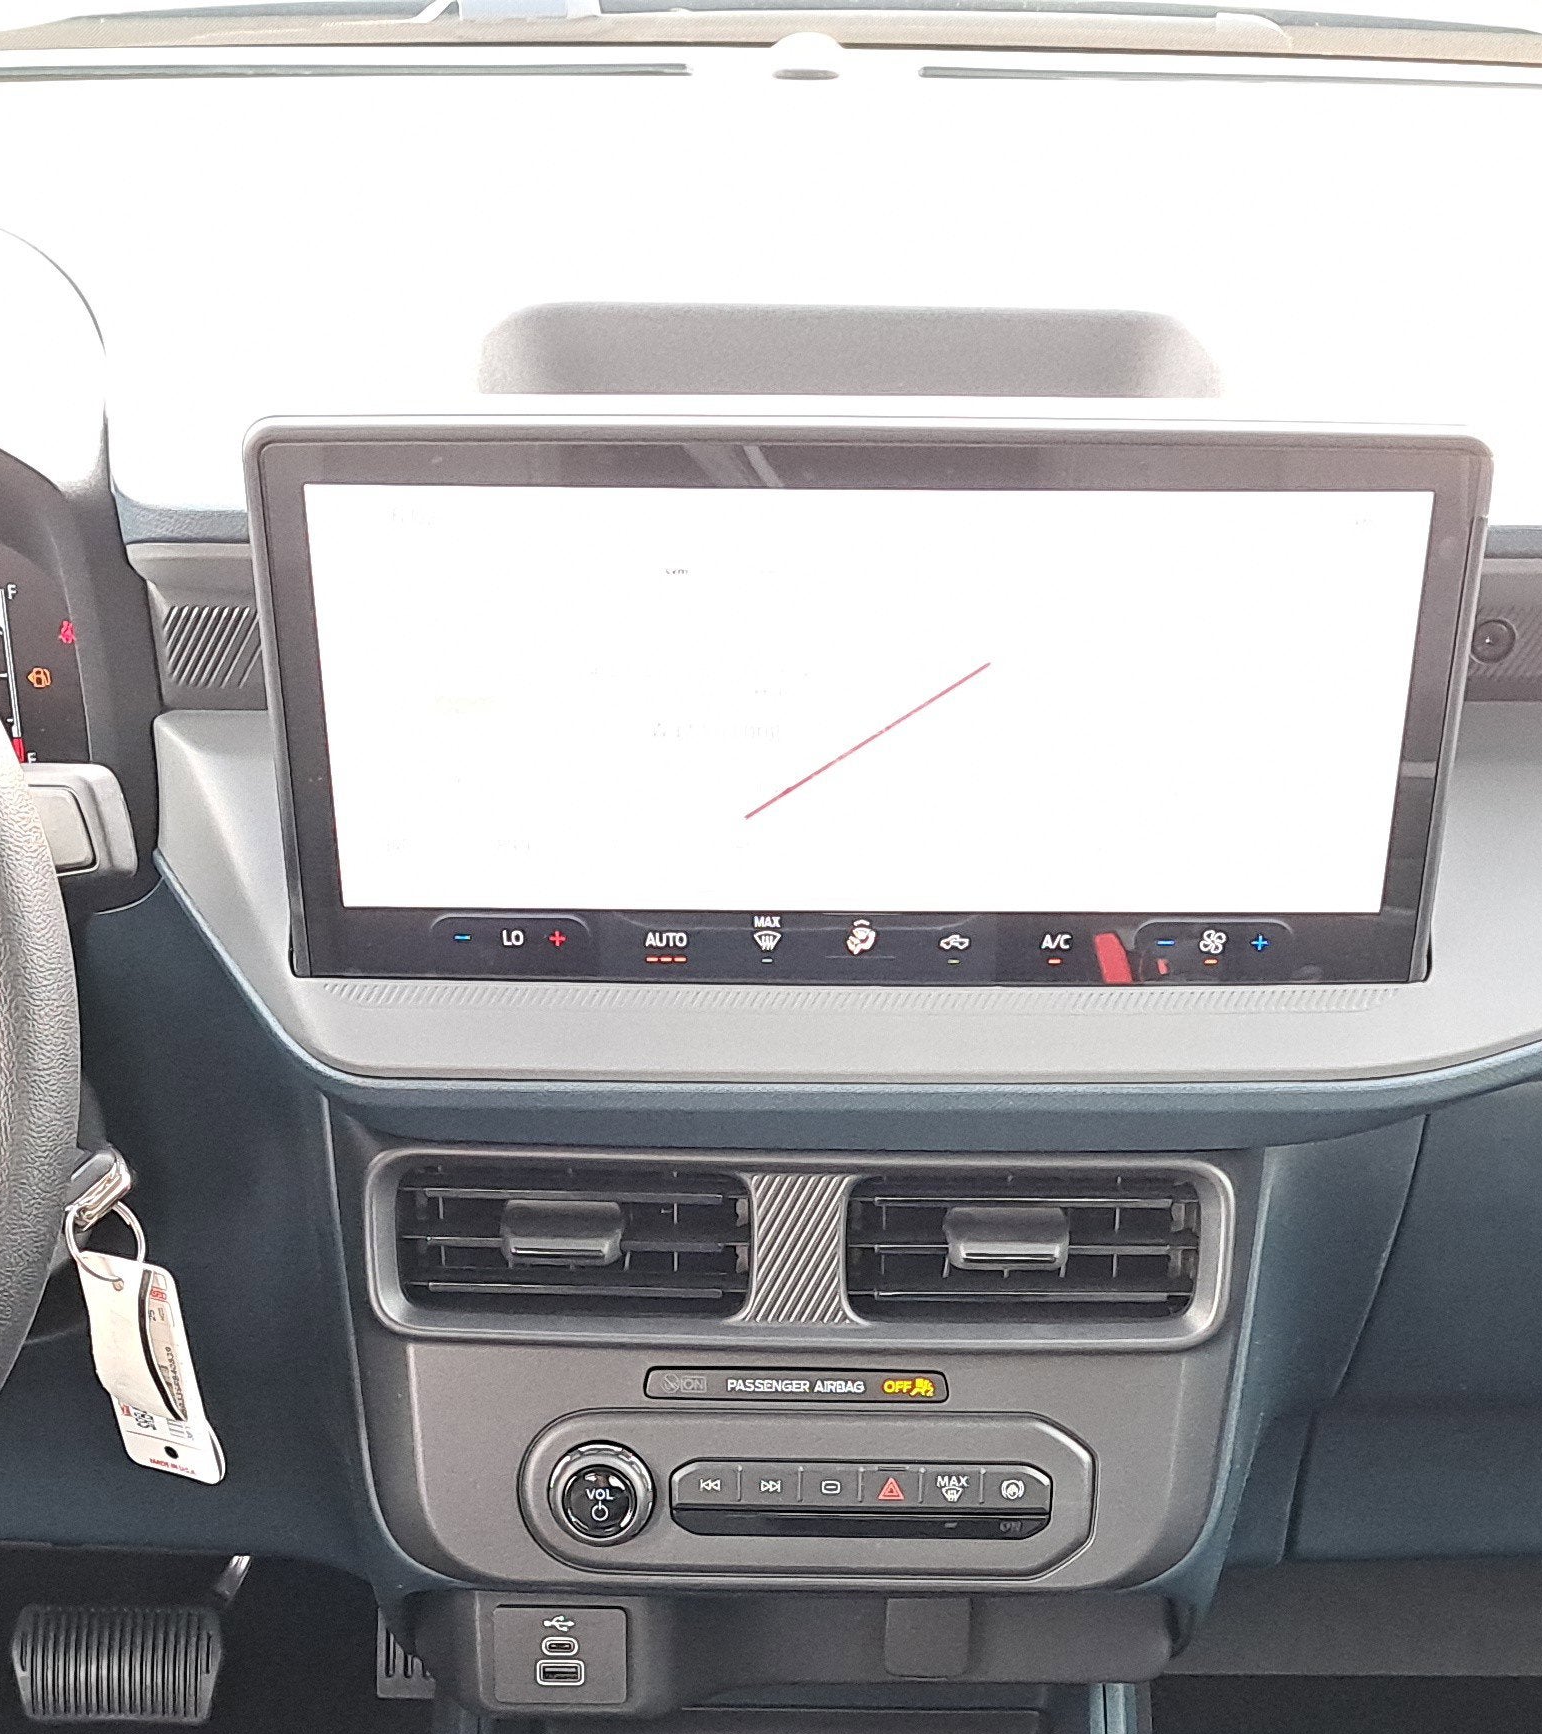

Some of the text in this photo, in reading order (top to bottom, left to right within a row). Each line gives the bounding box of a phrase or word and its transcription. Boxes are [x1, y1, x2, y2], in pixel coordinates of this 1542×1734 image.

[7, 583, 18, 600] F
[753, 915, 782, 928] MAX
[502, 929, 524, 946] LO
[645, 931, 688, 947] AUTO
[1041, 933, 1071, 950] A/C
[727, 1378, 810, 1393] PASSENGER
[813, 1379, 866, 1393] AIRBAG
[883, 1380, 912, 1393] OFF
[936, 1475, 969, 1487] MAX
[585, 1488, 614, 1501] VOL
